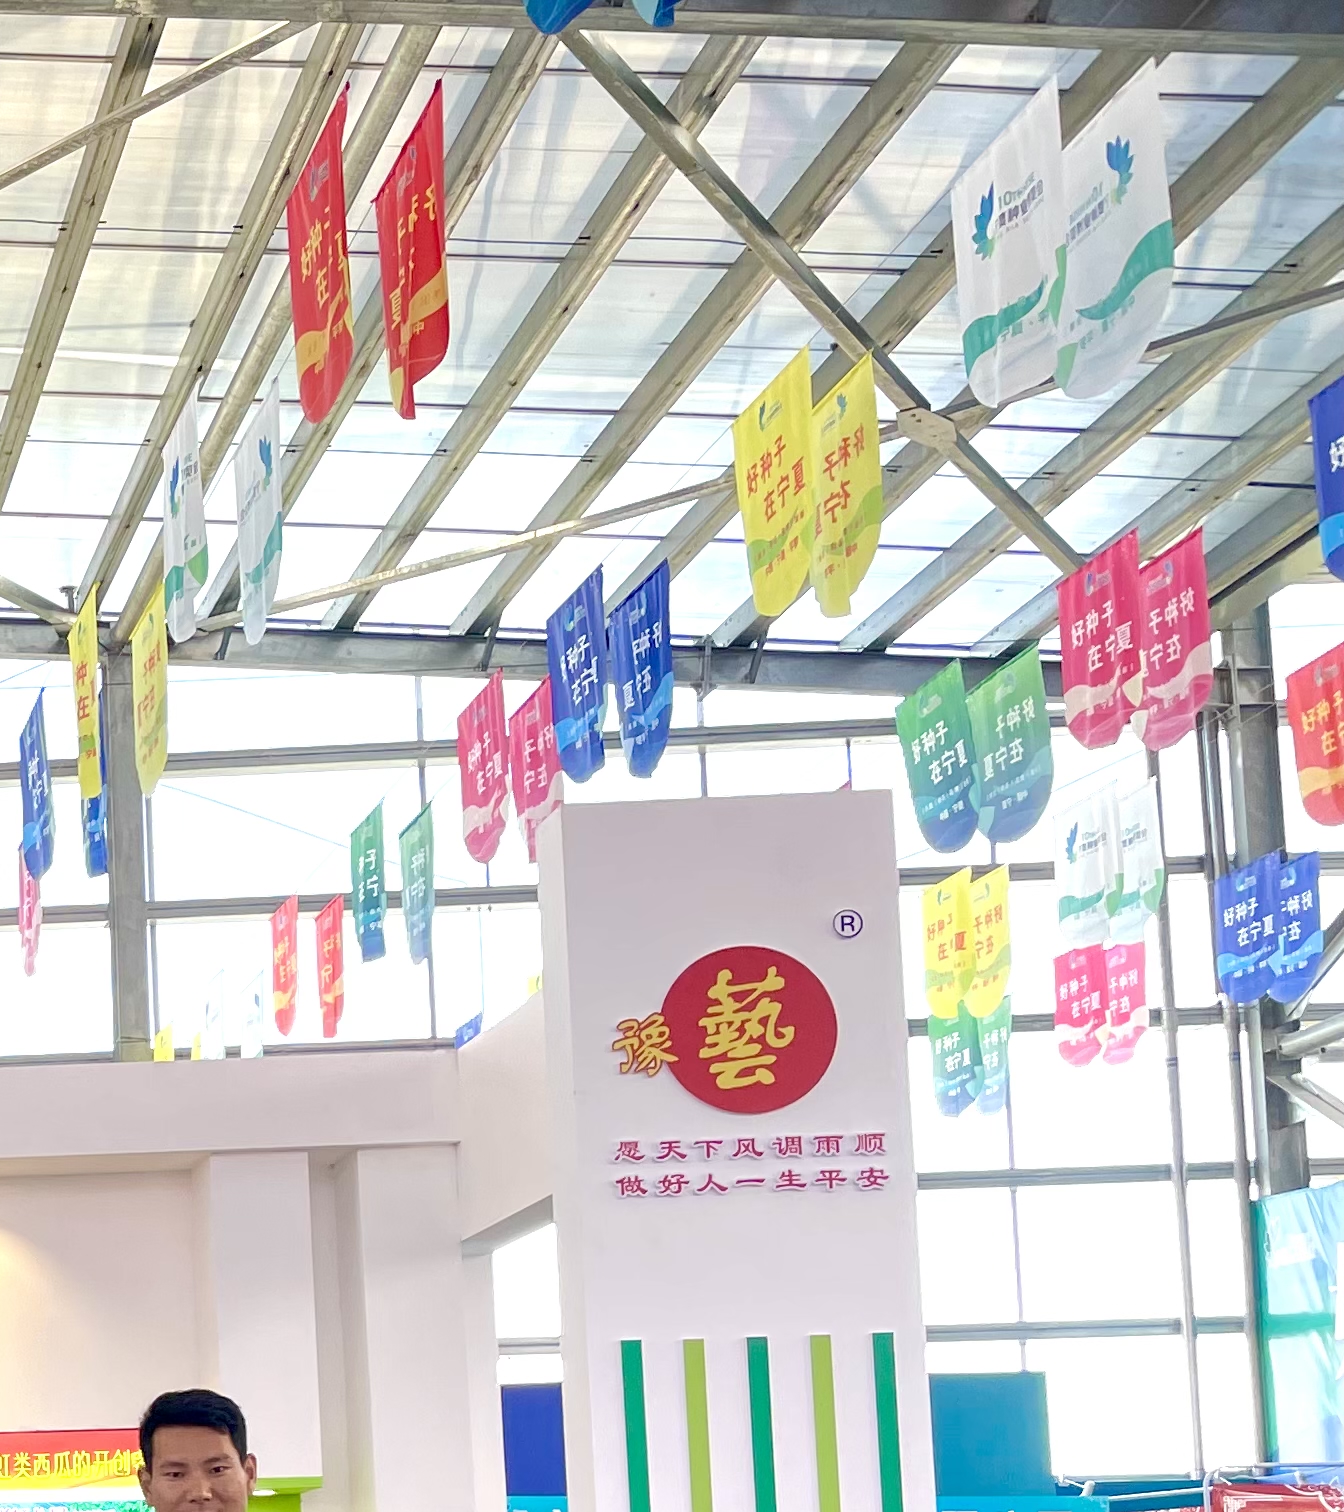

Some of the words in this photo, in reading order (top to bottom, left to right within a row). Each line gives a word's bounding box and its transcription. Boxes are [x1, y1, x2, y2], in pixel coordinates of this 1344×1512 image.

[747, 434, 786, 497] 好种子
[764, 457, 805, 523] 在宁夏
[1071, 602, 1114, 650] 好种子
[1088, 621, 1133, 671] 在宁夏
[911, 720, 949, 764] 好种子
[929, 739, 968, 785] 在宁夏
[1224, 899, 1259, 929] 好种子
[1237, 915, 1275, 947] 在宁夏
[1060, 976, 1088, 999] 好种子
[1071, 990, 1101, 1019] 在宁夏
[614, 1132, 886, 1161] 愿天下风调雨顺
[616, 1167, 889, 1195] 做好人一生平安
